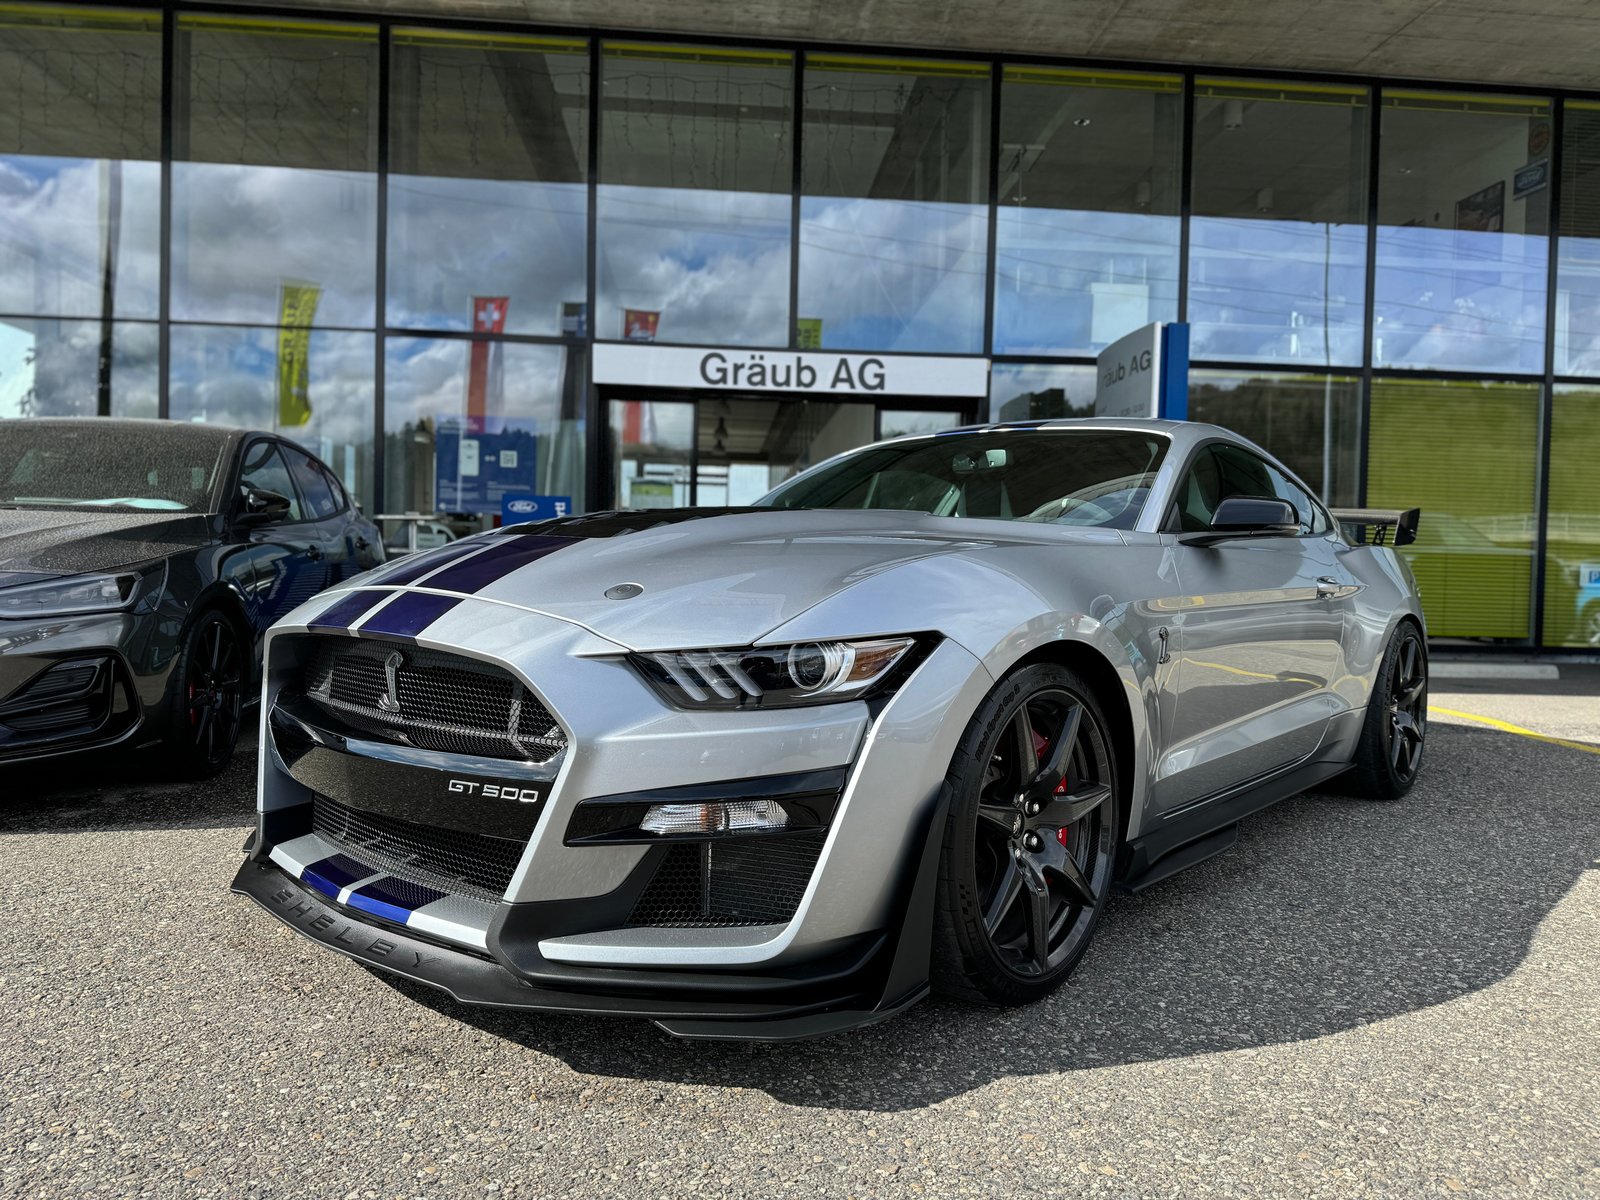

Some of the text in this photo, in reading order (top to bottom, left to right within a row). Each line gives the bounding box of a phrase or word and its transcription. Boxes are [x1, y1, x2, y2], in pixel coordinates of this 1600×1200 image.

[700, 352, 885, 391] Gräub AG
[1102, 349, 1151, 387] räub AG
[508, 500, 538, 513] Ford
[1003, 691, 1015, 707] Cup
[448, 779, 538, 802] GT 500
[270, 889, 441, 968] SHELBY
